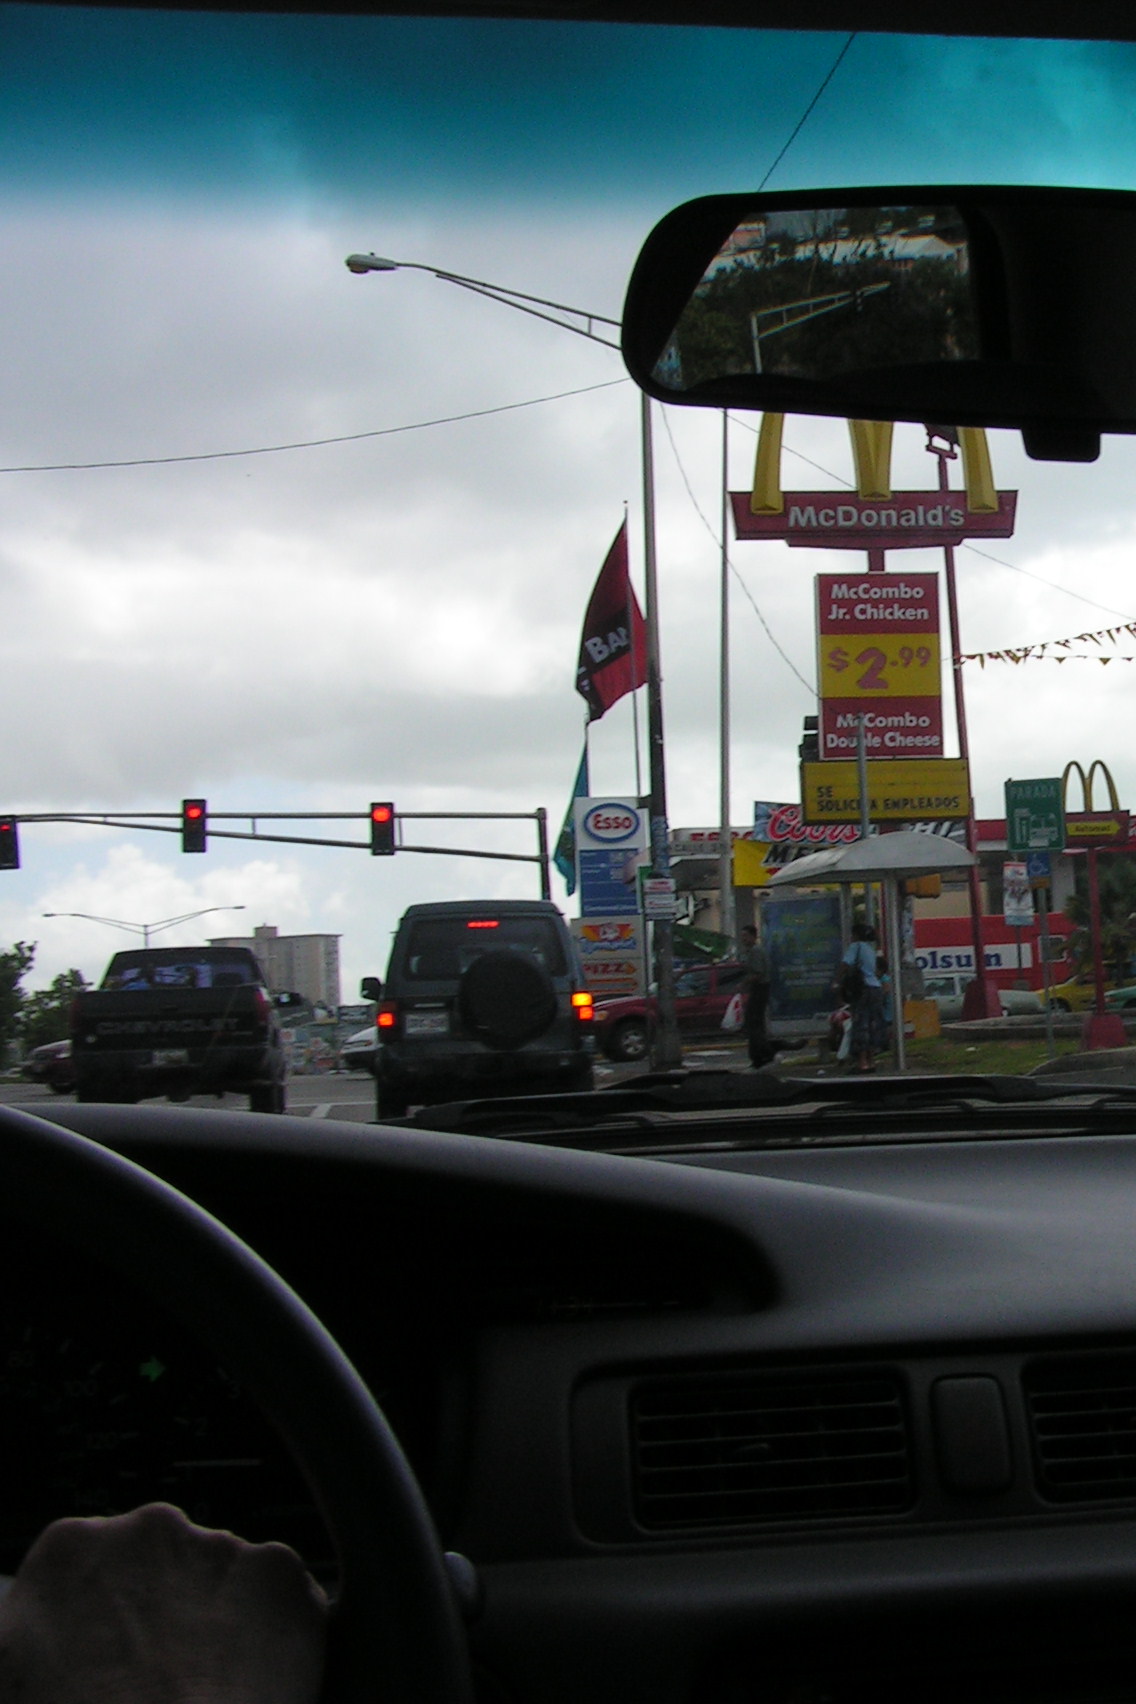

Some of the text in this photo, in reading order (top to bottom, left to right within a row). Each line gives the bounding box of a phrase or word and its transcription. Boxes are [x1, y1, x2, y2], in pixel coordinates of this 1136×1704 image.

[788, 505, 965, 528] McDonald's
[831, 583, 925, 600] McCombo
[828, 603, 930, 621] Jr. Chicken
[827, 646, 931, 690] $2.99
[826, 731, 941, 748] Doule Cheese
[817, 786, 833, 798] SE
[817, 796, 959, 811] SOLICIA EMPLEADOS
[914, 950, 1002, 970] olsum
